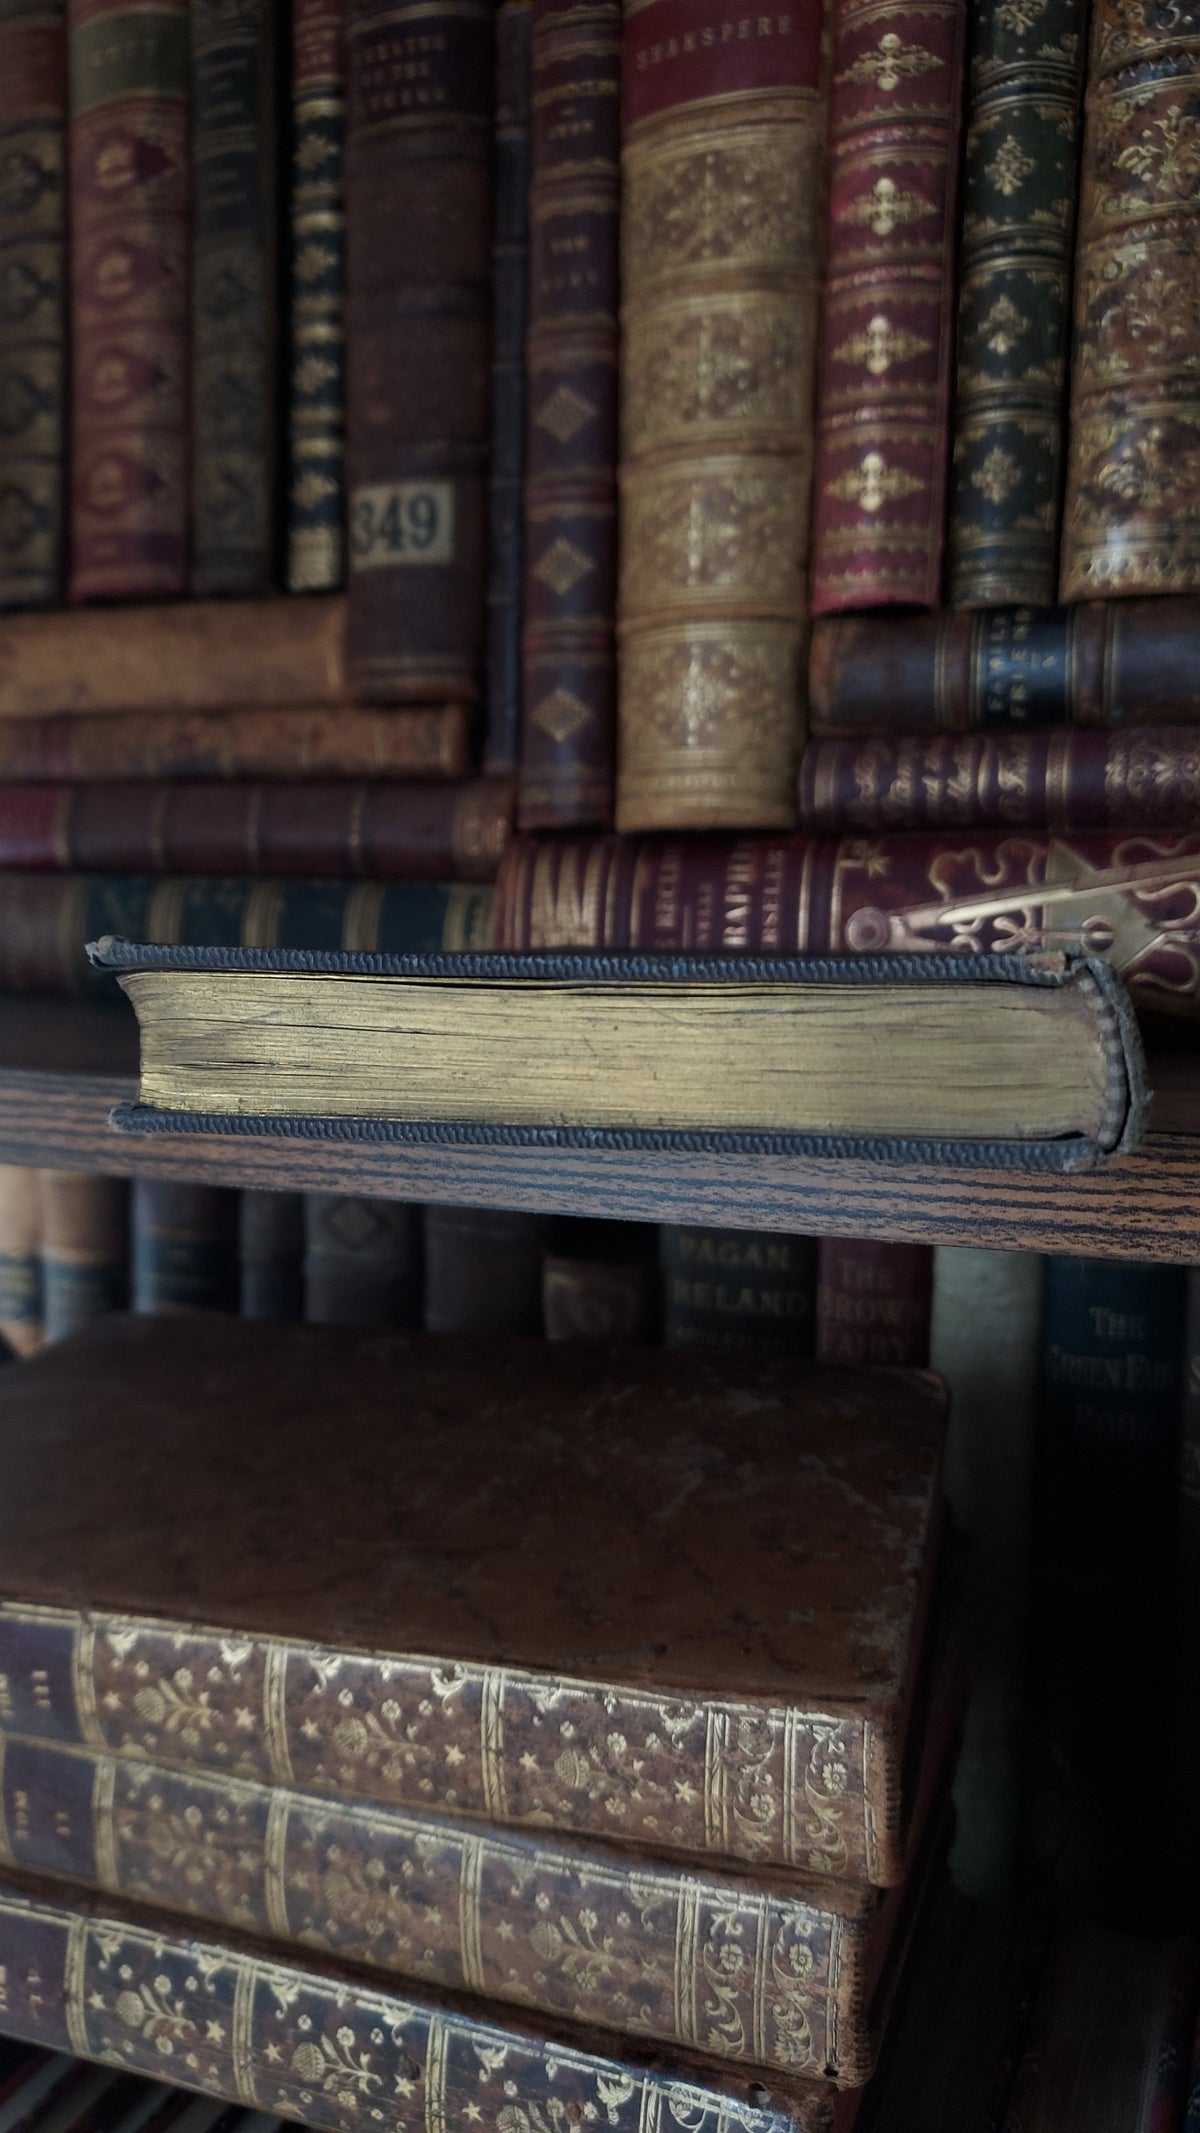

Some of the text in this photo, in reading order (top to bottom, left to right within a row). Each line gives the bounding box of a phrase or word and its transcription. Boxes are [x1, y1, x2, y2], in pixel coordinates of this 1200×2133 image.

[350, 493, 440, 554] 349
[679, 1235, 791, 1272] PAGAN
[838, 1256, 897, 1292] THE
